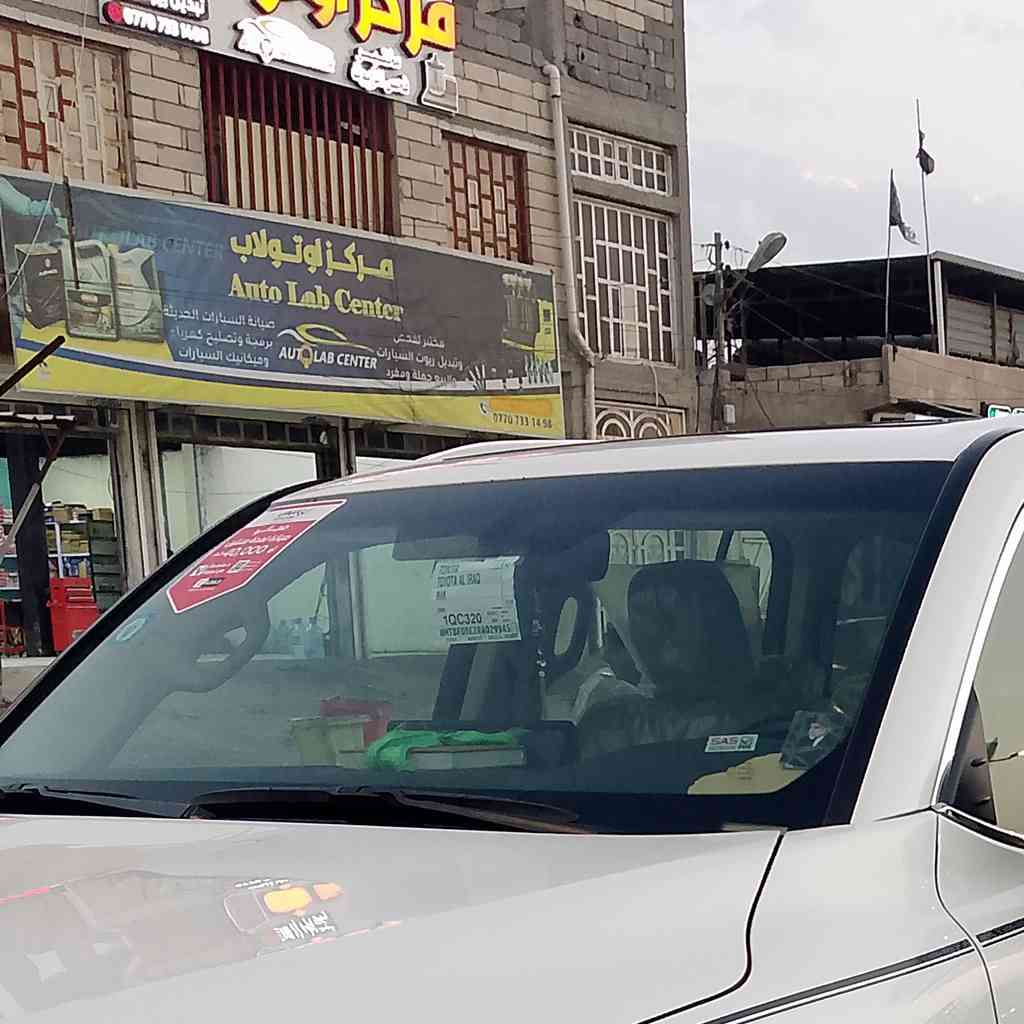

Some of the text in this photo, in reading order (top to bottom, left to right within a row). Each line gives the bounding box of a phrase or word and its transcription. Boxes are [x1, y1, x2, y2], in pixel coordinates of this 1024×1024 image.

[325, 240, 394, 282] مركز
[228, 273, 404, 322] Auto Lab Center
[202, 311, 246, 327] السيارات
[179, 346, 222, 362] السيارات
[314, 350, 334, 365] LAB
[336, 353, 377, 370] CENTER
[376, 347, 414, 361] السيارات
[492, 412, 513, 425] 0770
[442, 612, 482, 625] 1QC320
